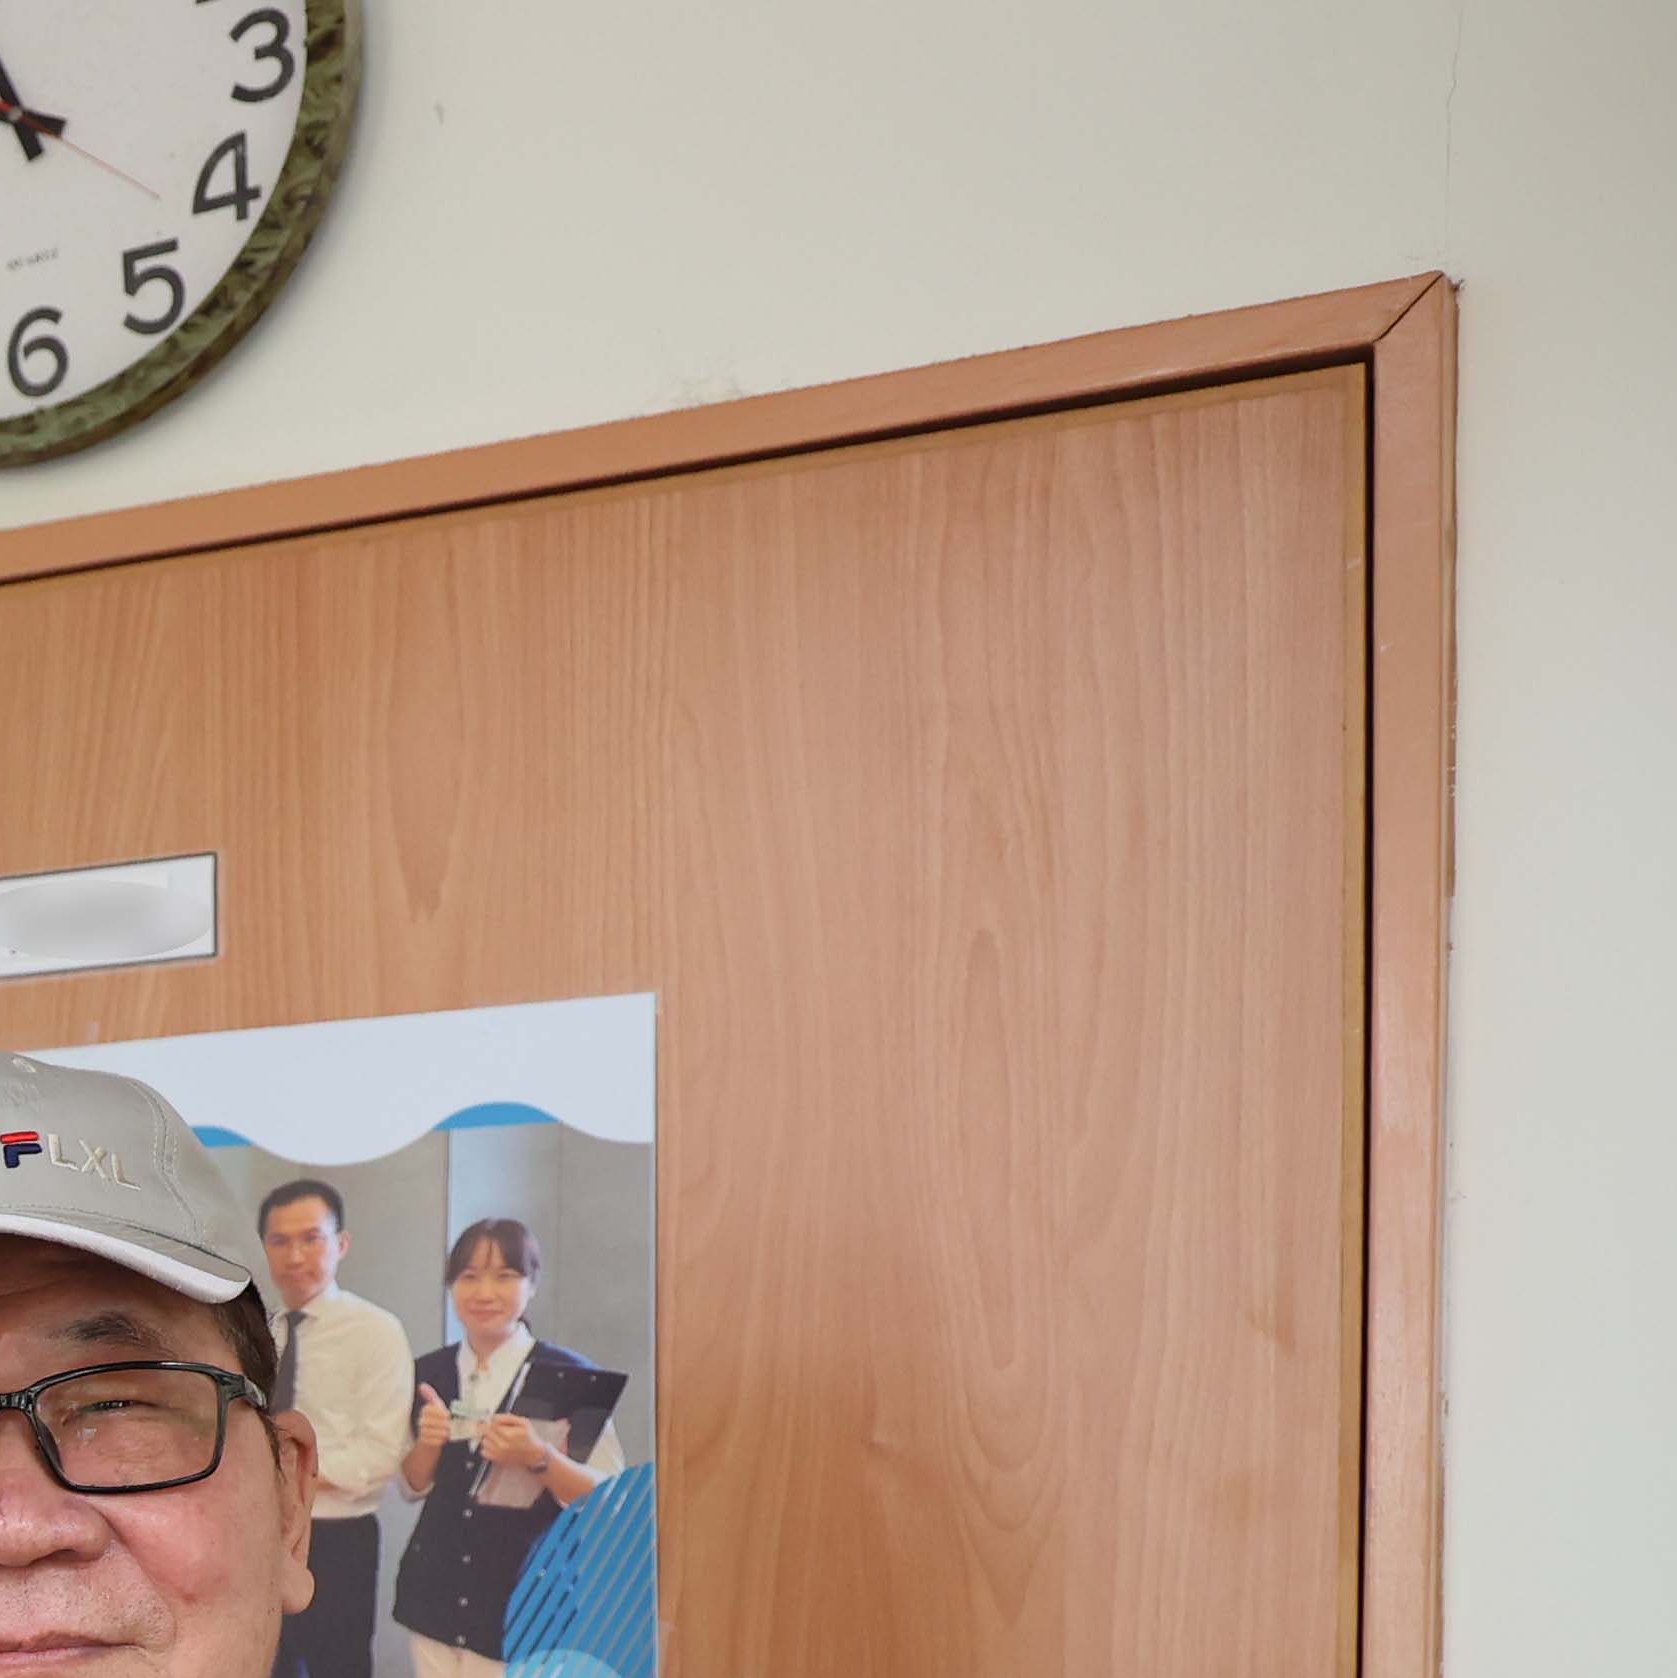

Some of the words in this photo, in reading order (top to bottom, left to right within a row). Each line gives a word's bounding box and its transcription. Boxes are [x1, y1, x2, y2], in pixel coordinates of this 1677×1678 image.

[230, 8, 295, 102] 3
[192, 131, 262, 221] 4
[122, 238, 186, 335] 5
[7, 306, 68, 398] 6
